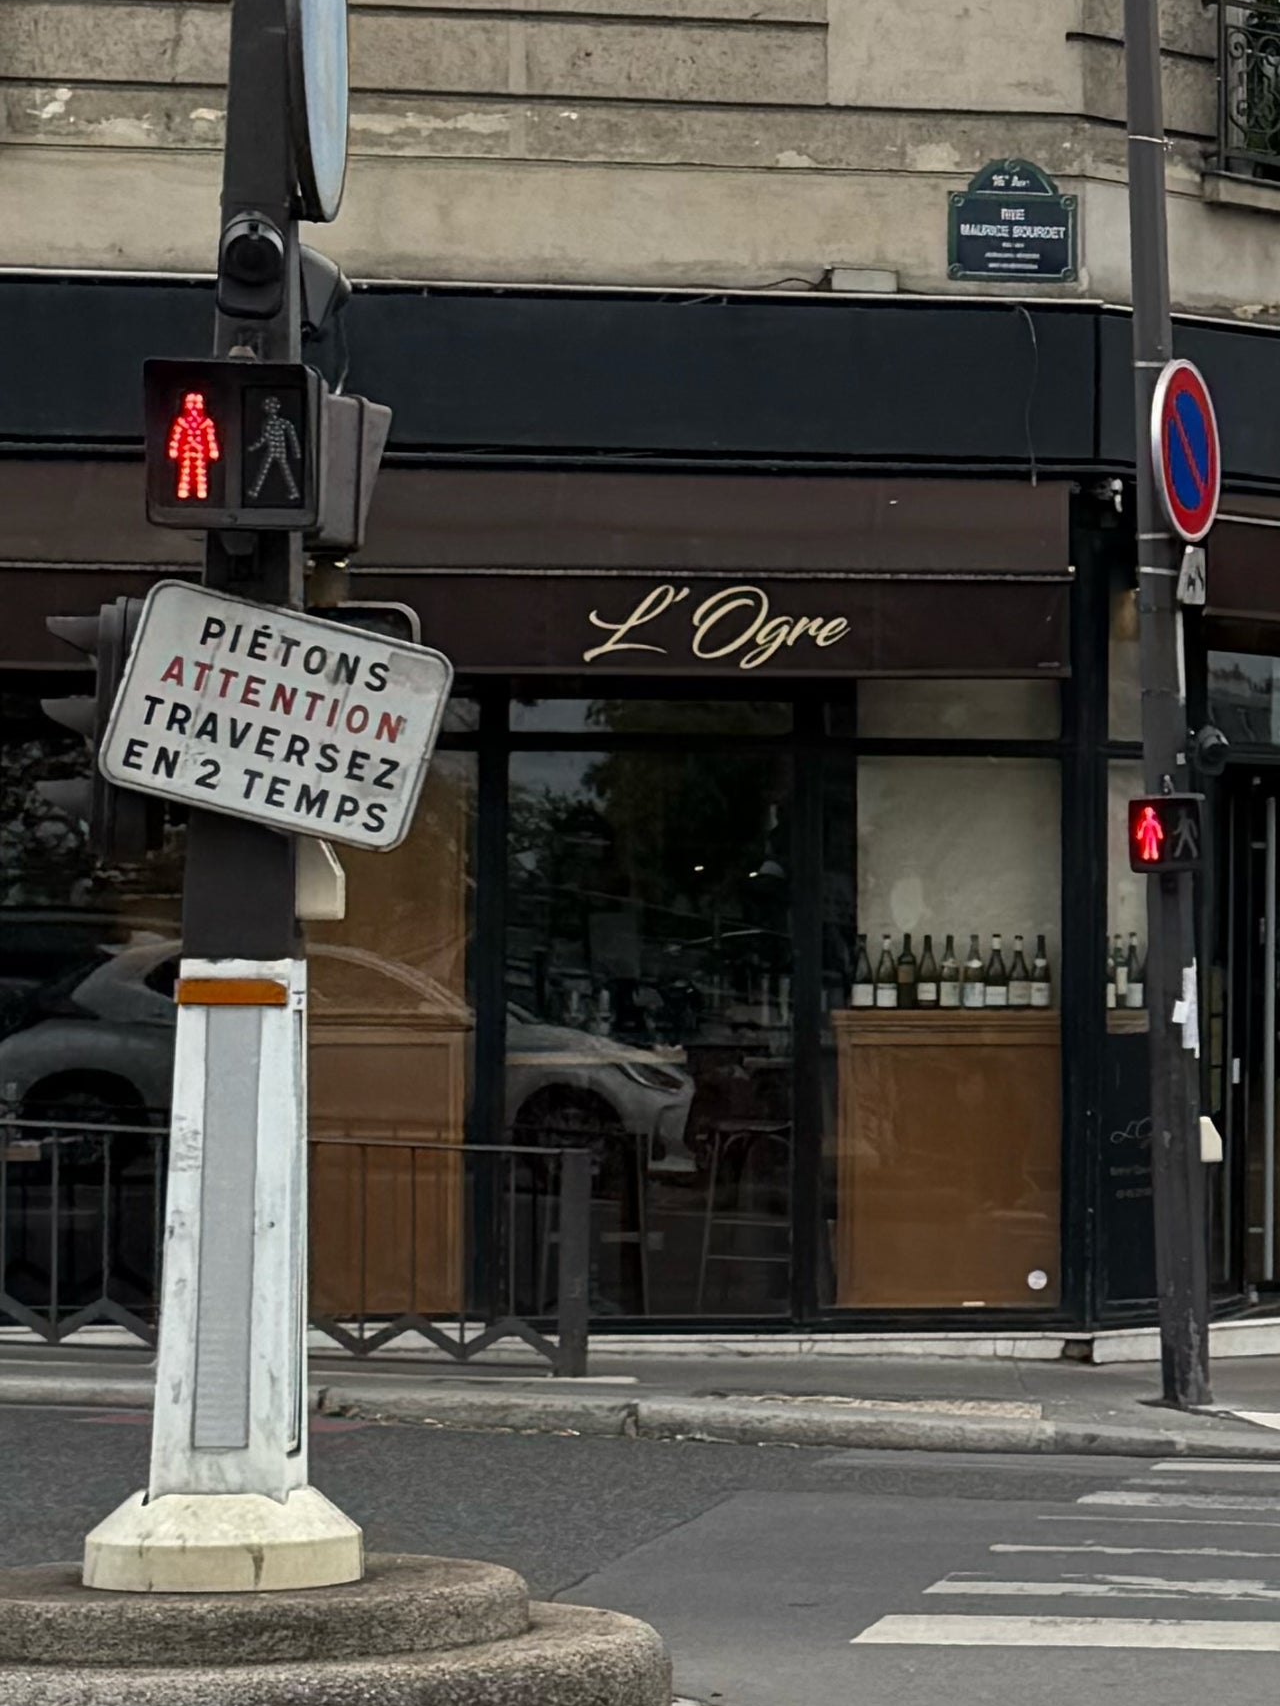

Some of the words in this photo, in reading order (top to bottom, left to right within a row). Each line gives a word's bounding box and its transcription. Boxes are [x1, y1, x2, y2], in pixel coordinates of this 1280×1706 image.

[200, 616, 390, 692] PIÉTONS
[583, 584, 851, 669] L'Ogre
[144, 695, 400, 790] TRAVERSEZ
[160, 656, 404, 743] ATTENTION
[122, 738, 181, 779] EN
[195, 759, 221, 790] 2
[242, 769, 388, 833] TEMPS
